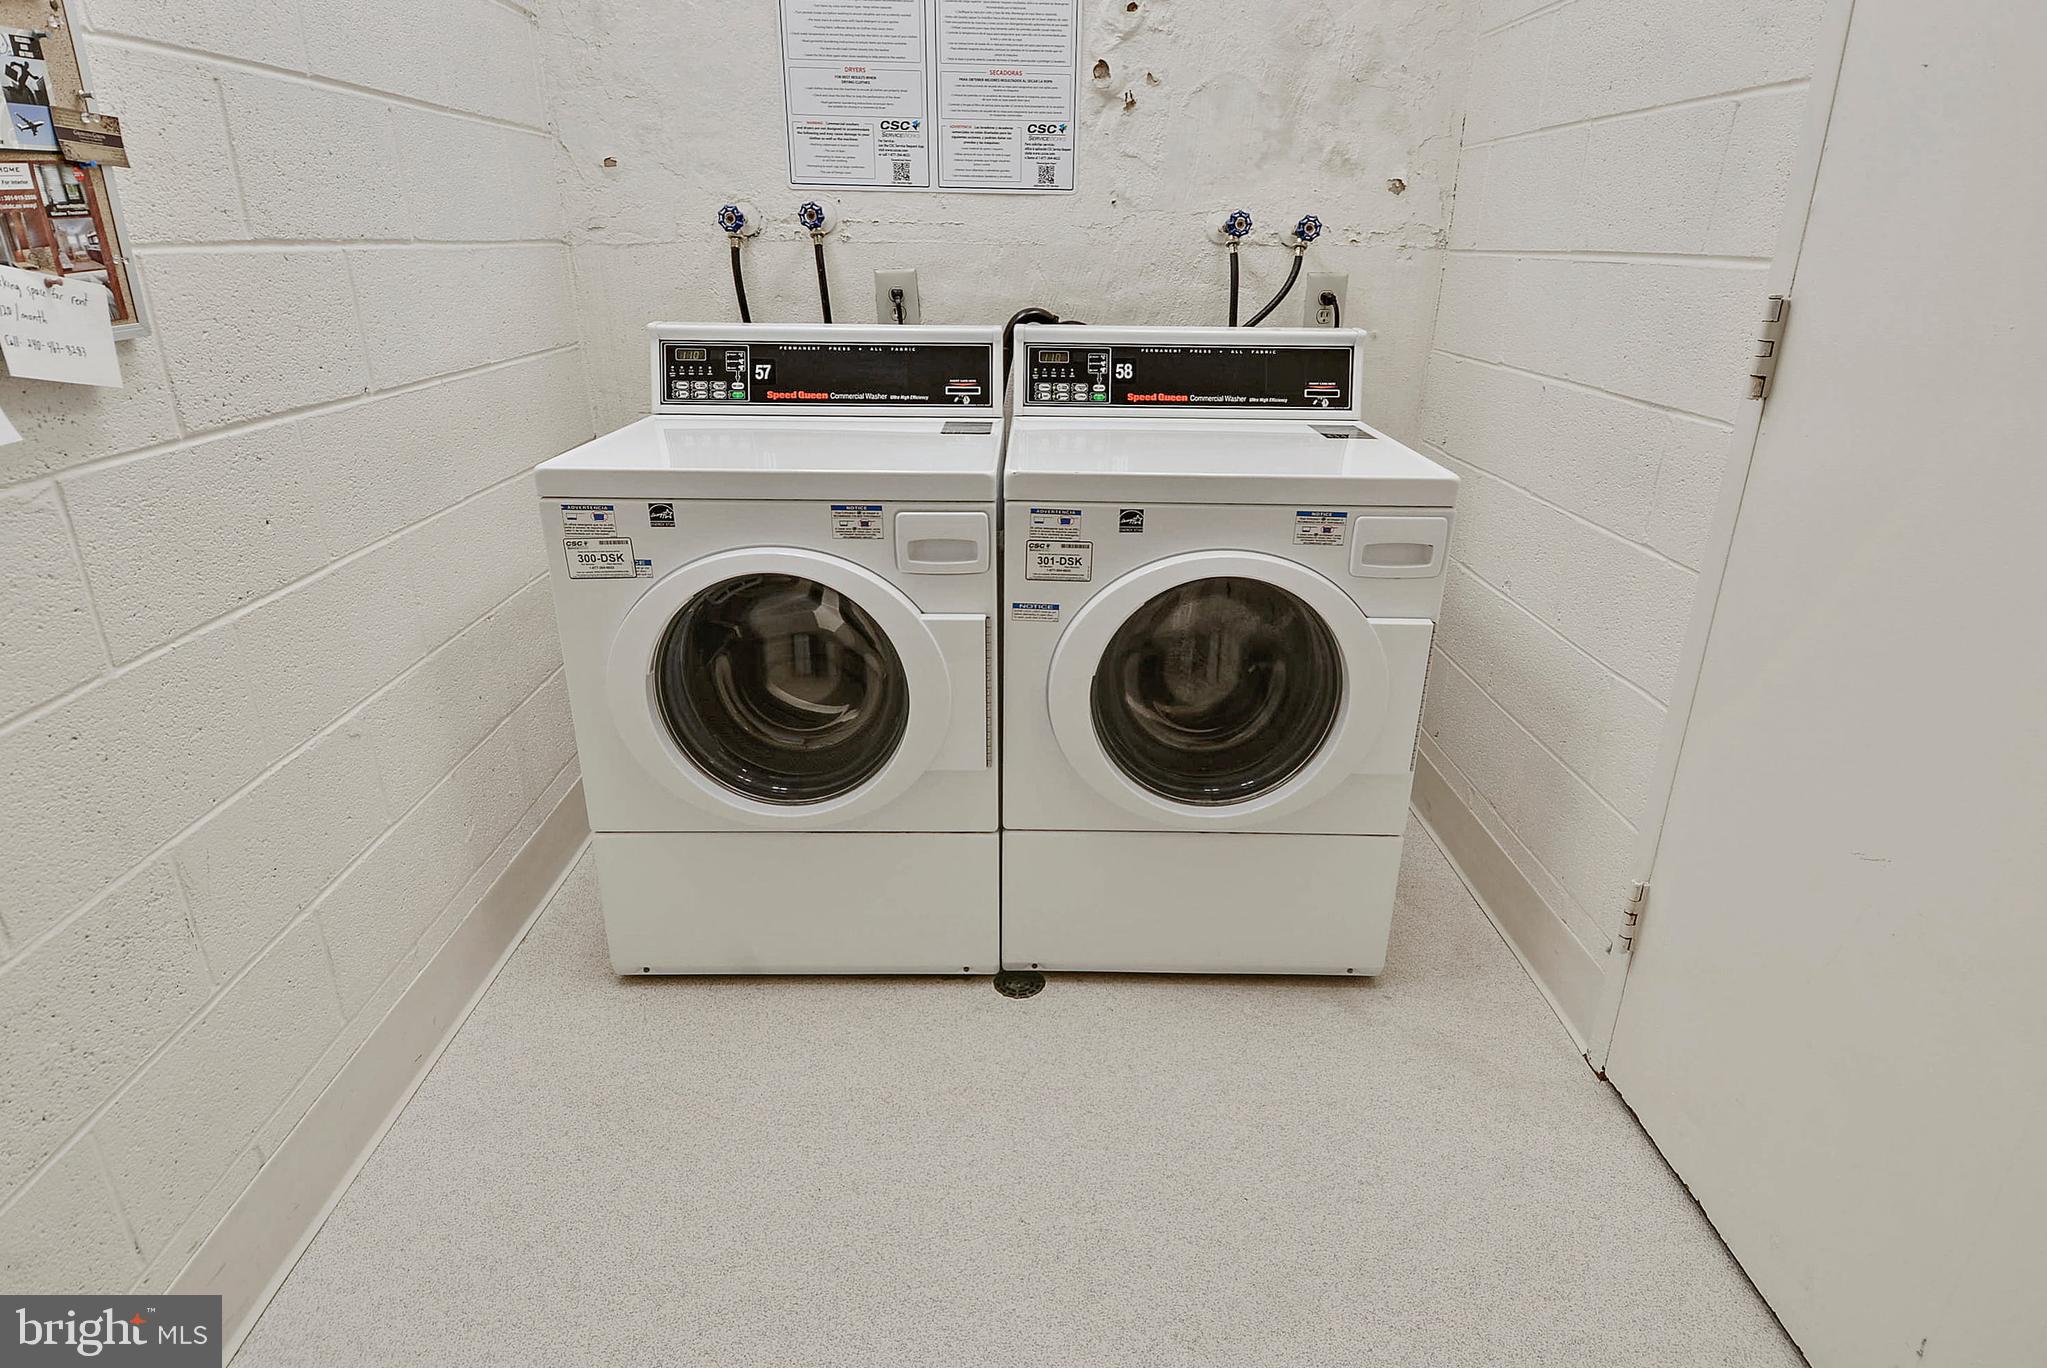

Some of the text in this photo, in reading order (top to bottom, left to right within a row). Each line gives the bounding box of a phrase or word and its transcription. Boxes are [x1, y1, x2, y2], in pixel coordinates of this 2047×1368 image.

[881, 120, 910, 130] CSC
[1028, 124, 1057, 134] CSC
[755, 364, 772, 380] 57
[1115, 364, 1133, 379] 58
[767, 391, 797, 401] Speed
[798, 391, 828, 400] Queen
[1127, 393, 1157, 402] Speed
[1158, 393, 1188, 402] Queen
[1190, 394, 1224, 402] Commercial
[577, 553, 624, 563] 300-DSK
[1037, 556, 1082, 566] 301-DSK
